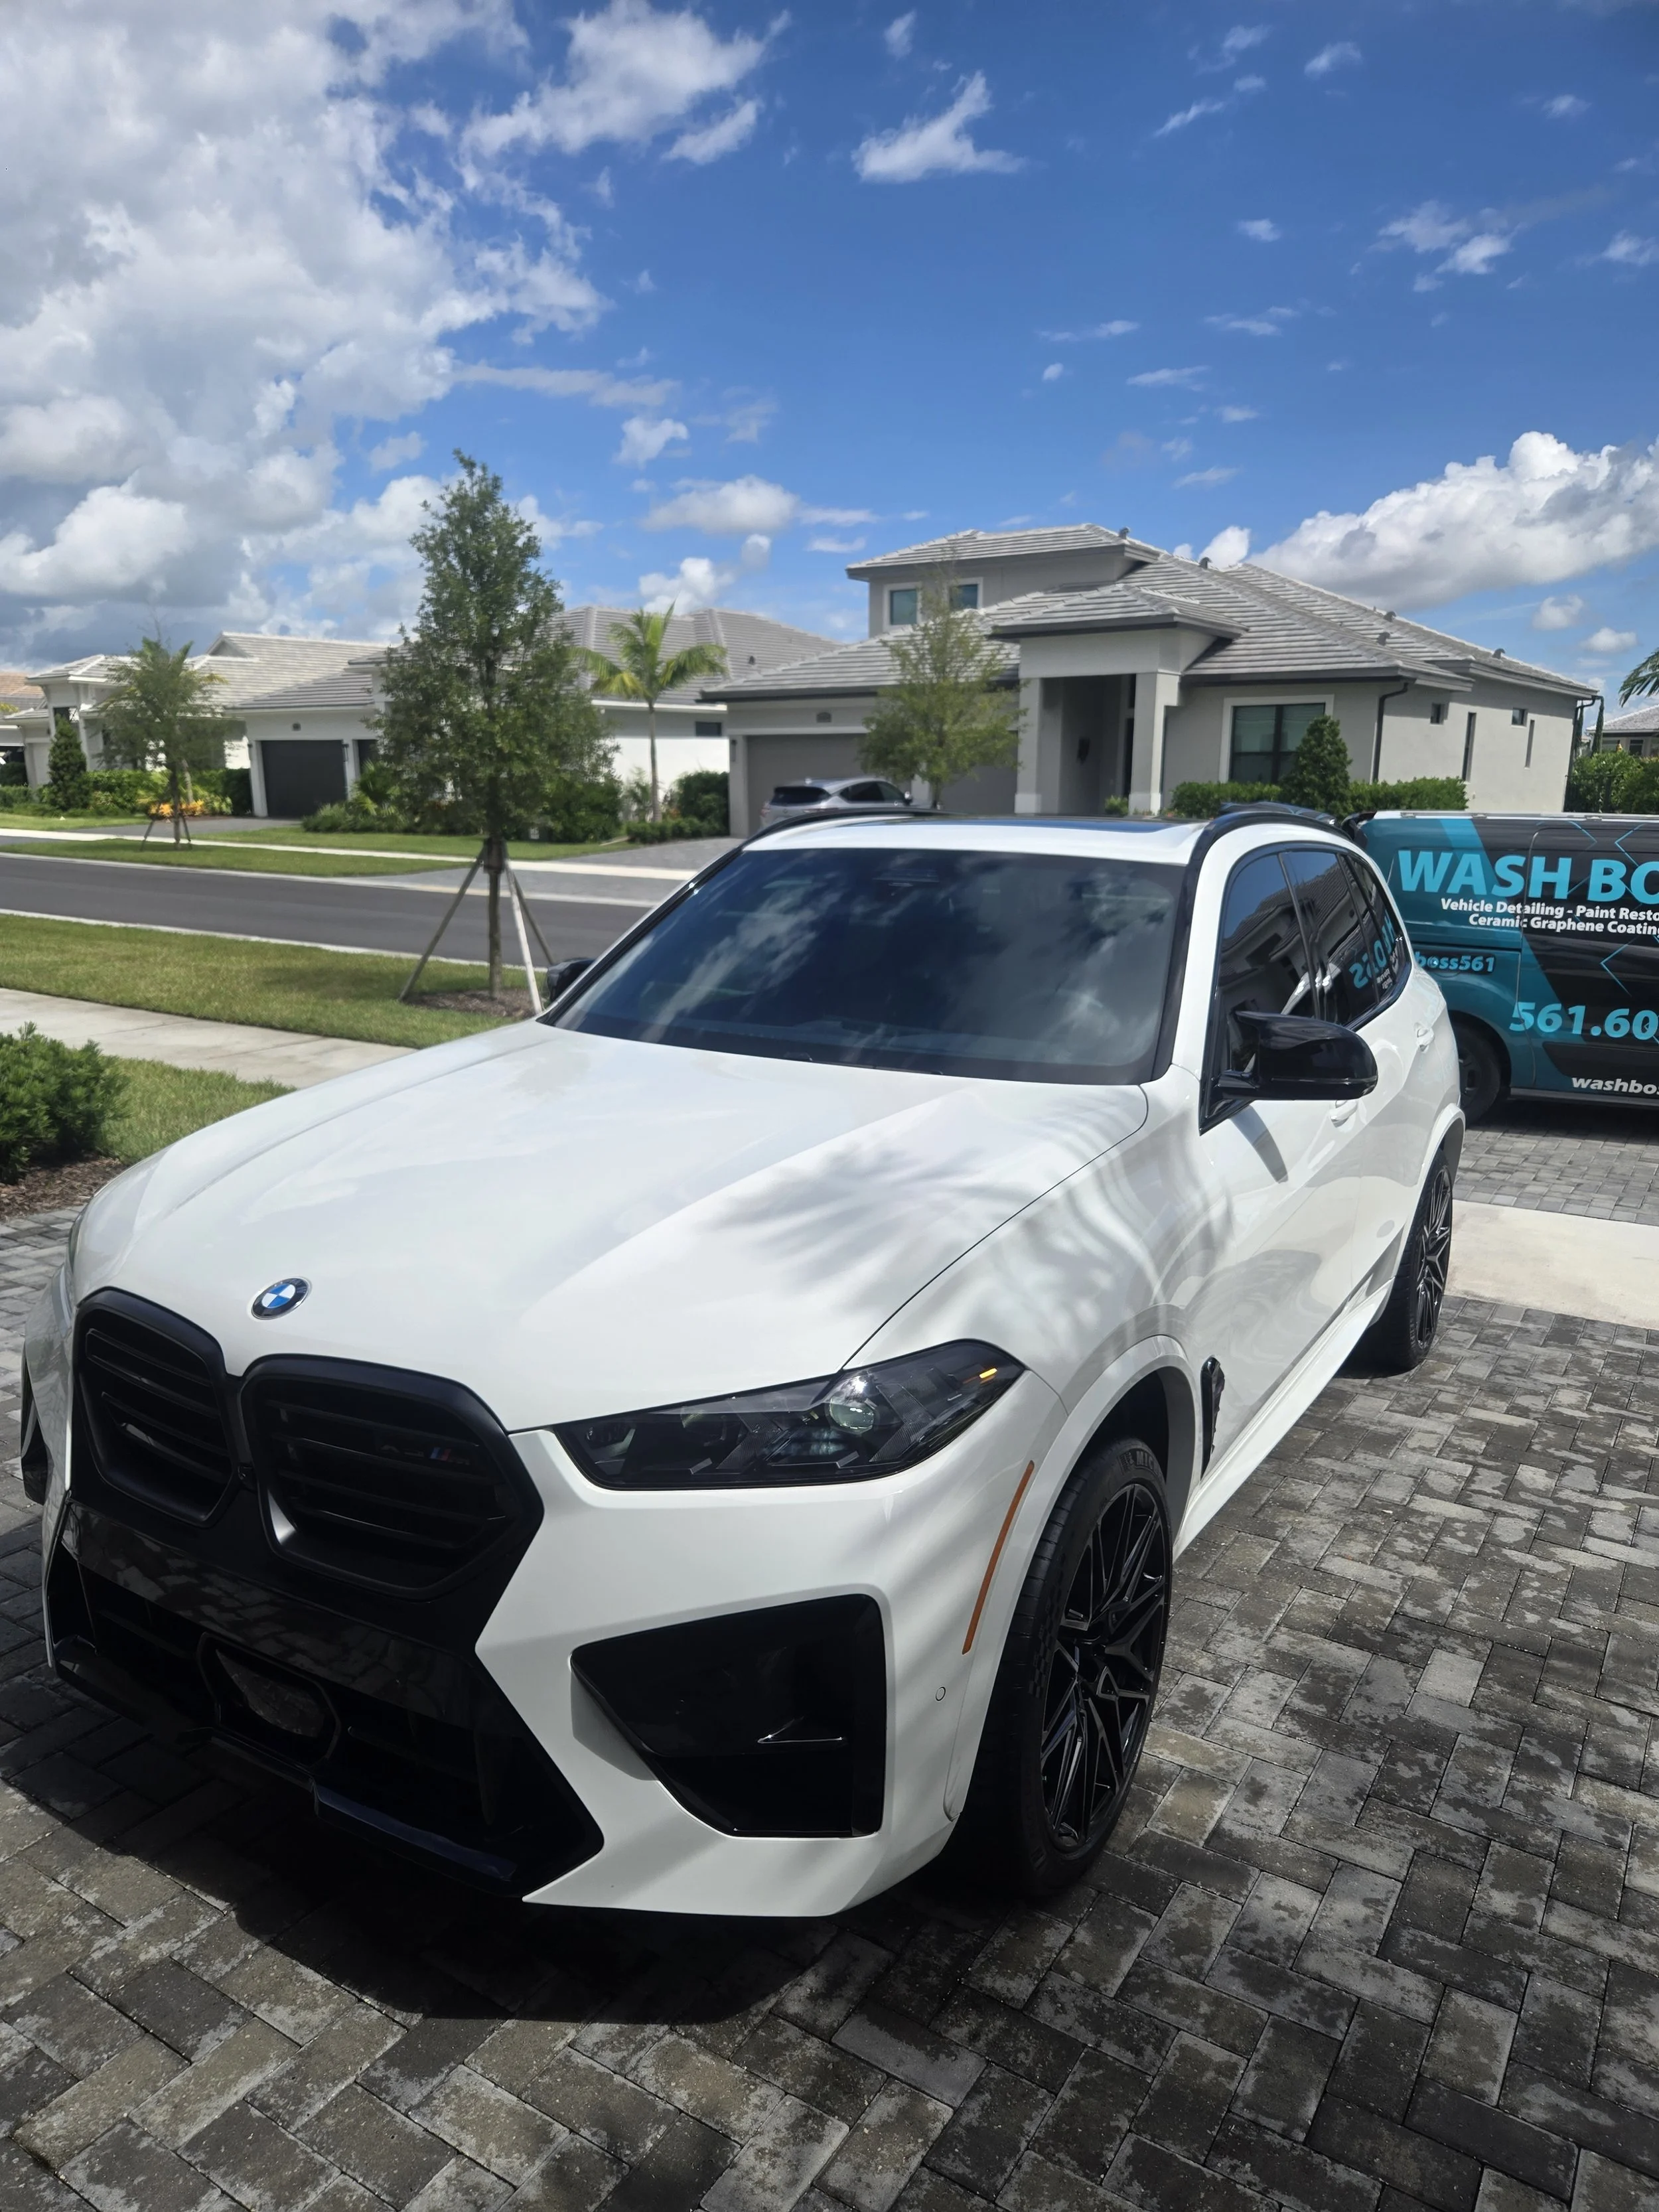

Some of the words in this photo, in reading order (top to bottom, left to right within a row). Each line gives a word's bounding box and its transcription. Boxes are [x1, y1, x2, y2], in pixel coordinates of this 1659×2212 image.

[1398, 850, 1572, 899] WASH
[1441, 898, 1493, 912] Vehicle
[1496, 901, 1565, 919] Detailing
[1575, 905, 1617, 919] Paint
[1469, 913, 1528, 928] Ceramic
[1530, 917, 1605, 932] Graphene
[1607, 921, 1659, 938] Coatin
[1571, 1077, 1659, 1095] washbo
